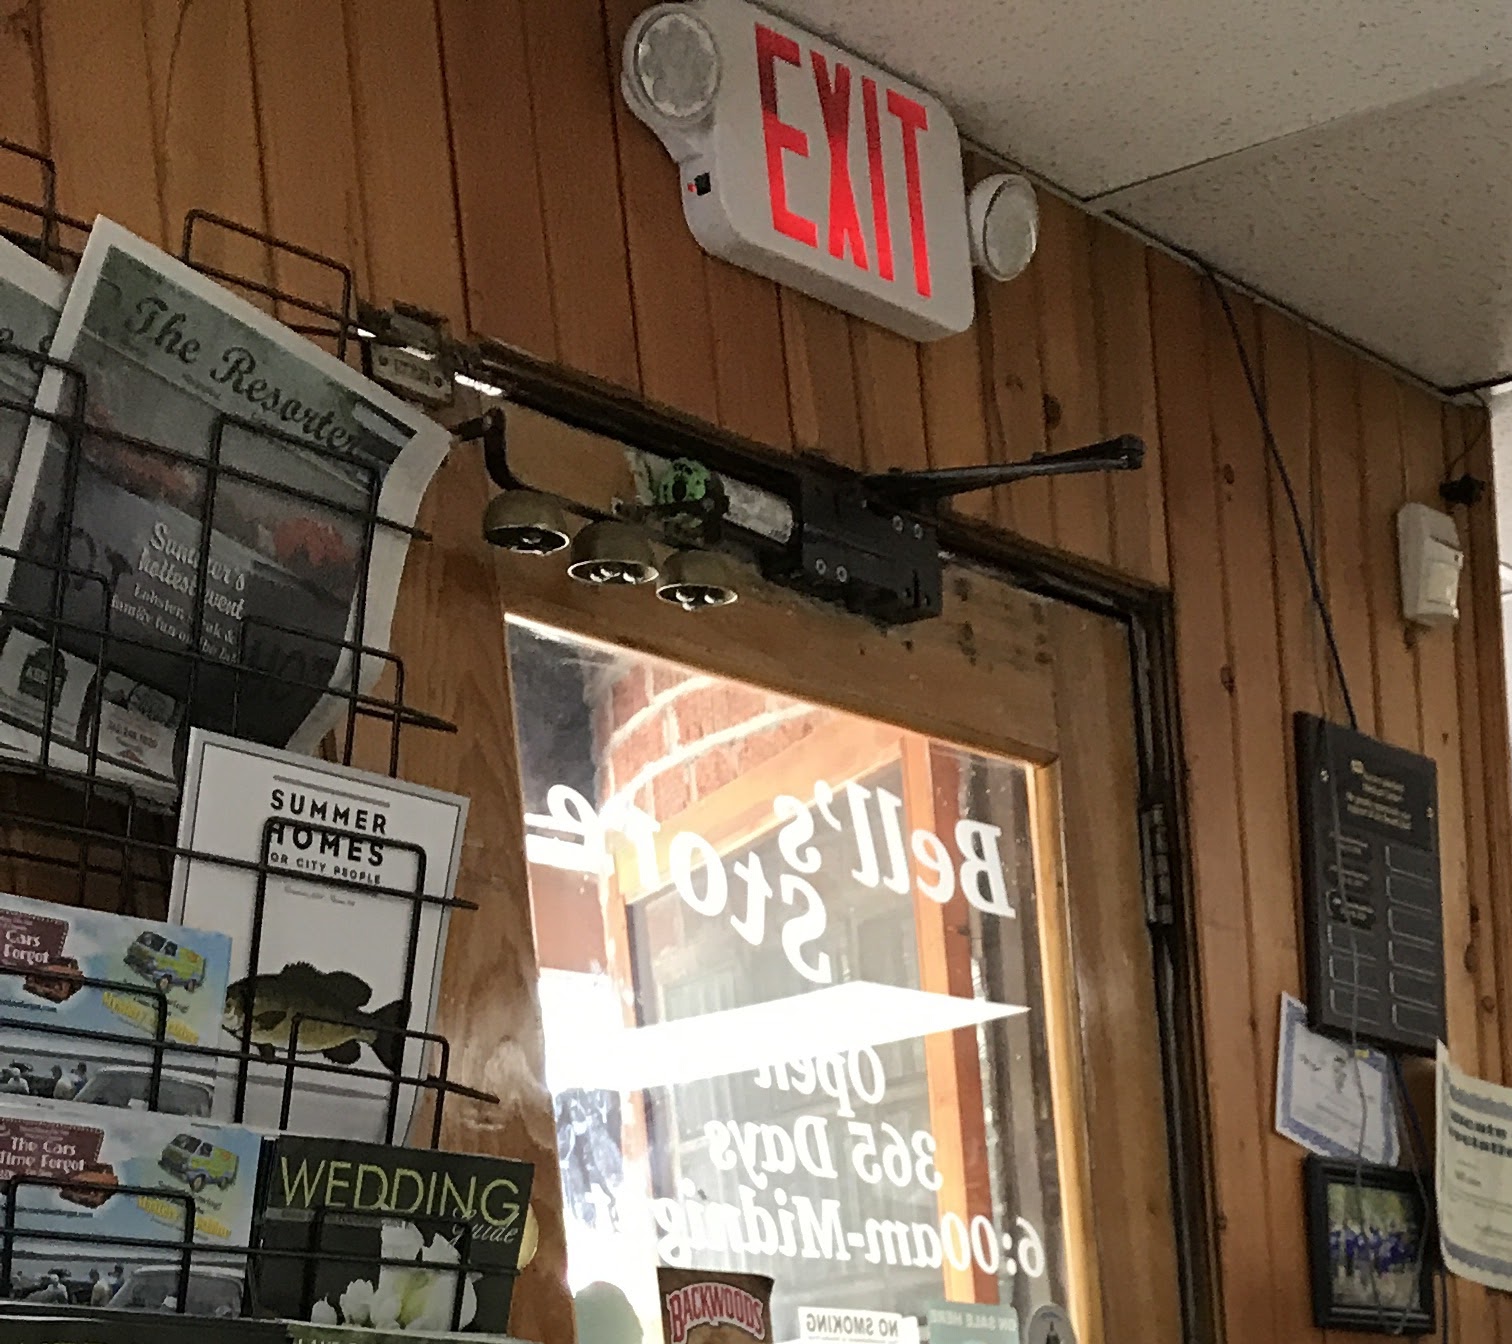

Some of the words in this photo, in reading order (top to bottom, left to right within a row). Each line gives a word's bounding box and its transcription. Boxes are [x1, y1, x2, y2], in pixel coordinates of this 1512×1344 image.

[755, 22, 931, 298] EXIT
[124, 297, 201, 364] The
[210, 346, 359, 454] Resorter
[139, 547, 198, 597] hottest
[270, 788, 388, 835] SUMMER
[296, 856, 327, 874] CITY
[333, 864, 382, 886] PEOPLE
[4, 942, 50, 965] Forgot
[5, 929, 41, 948] Cars
[10, 1136, 37, 1152] The
[42, 1139, 76, 1156] Cars
[40, 1154, 86, 1175] Forgot
[278, 1155, 521, 1228] WEDDING
